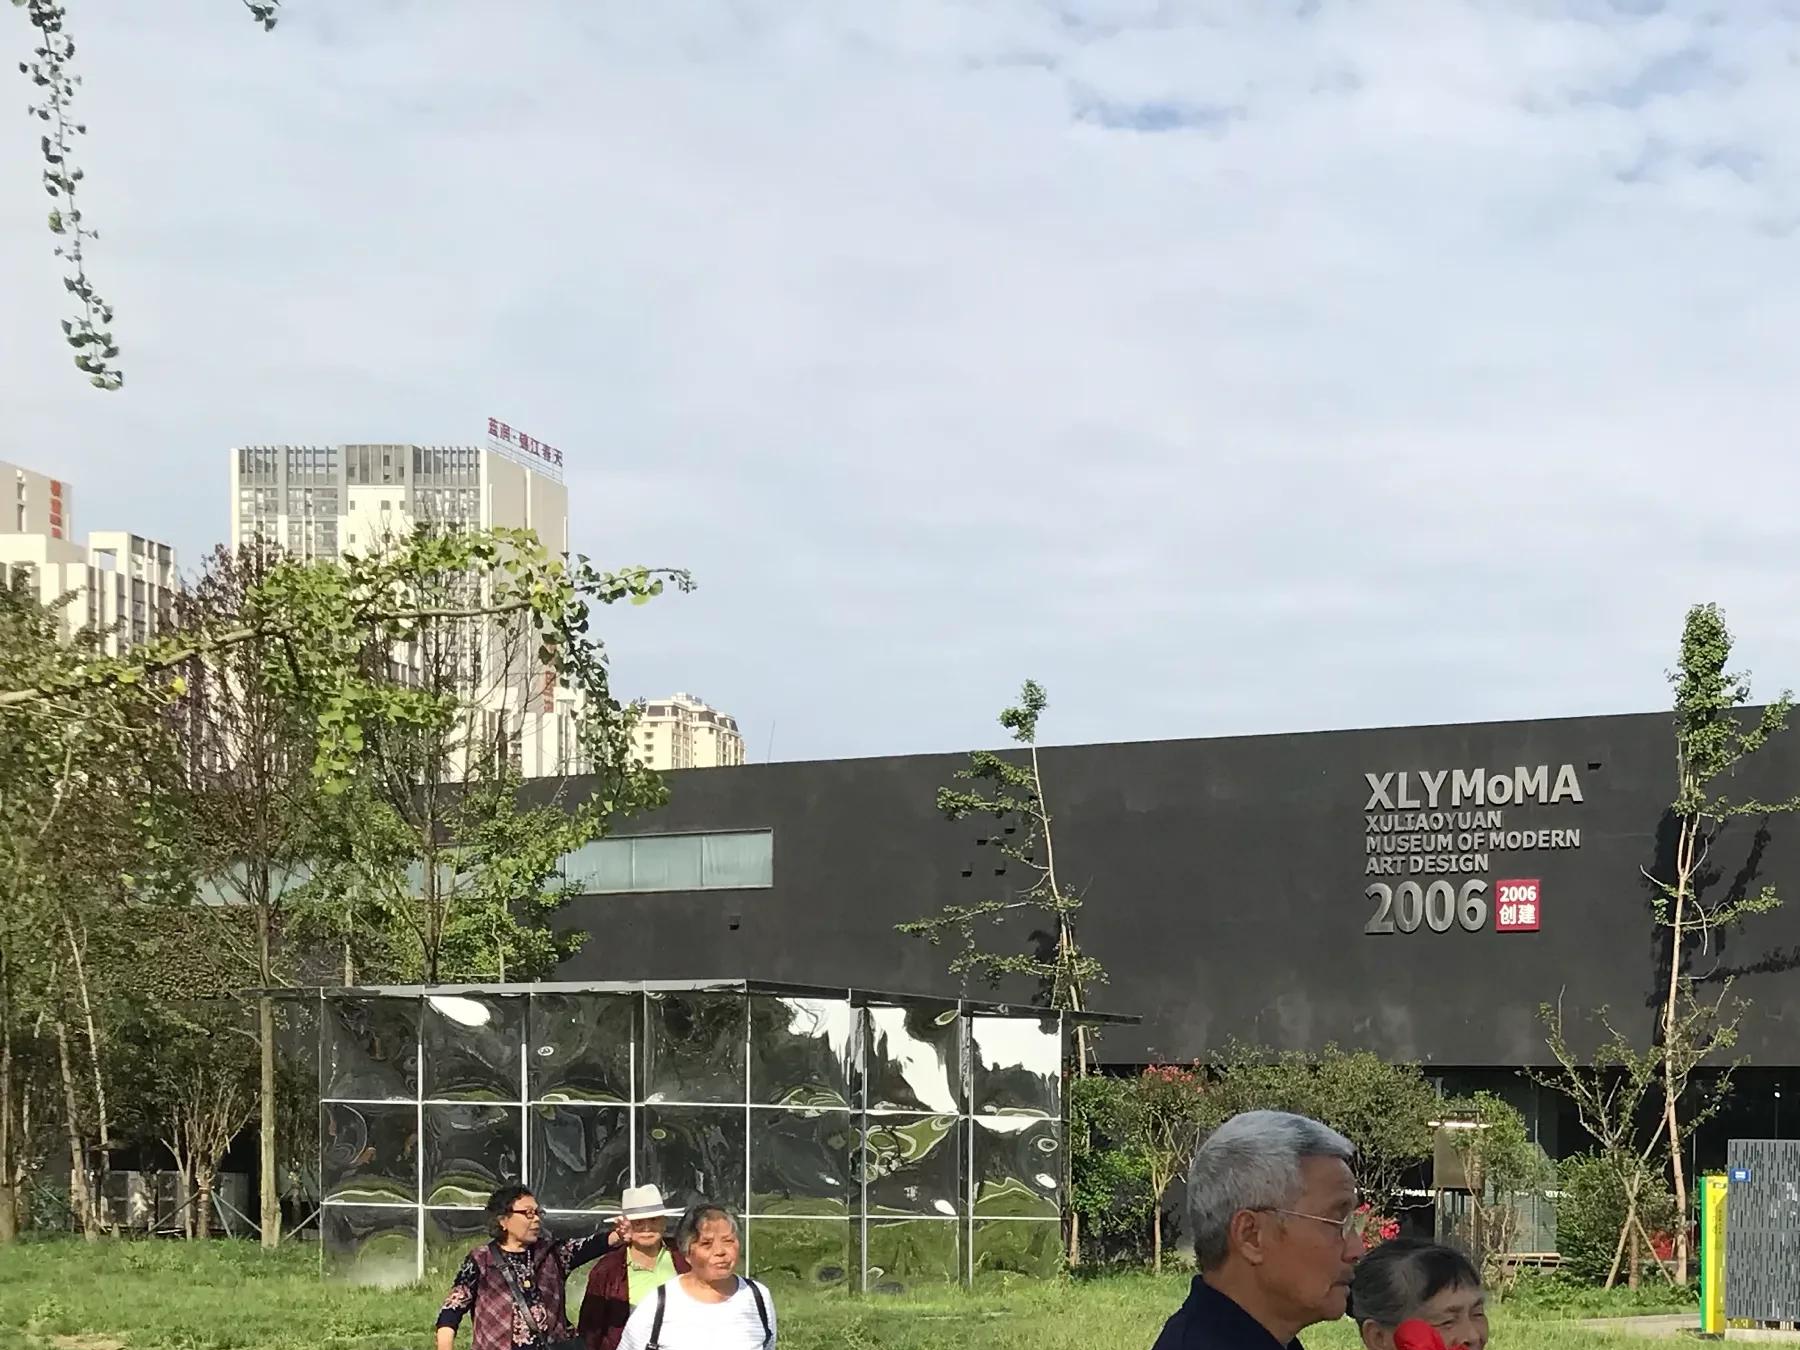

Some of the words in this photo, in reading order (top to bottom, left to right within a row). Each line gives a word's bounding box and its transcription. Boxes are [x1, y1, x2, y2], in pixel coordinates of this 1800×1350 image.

[1364, 764, 1584, 811] XLYMoMA
[1365, 811, 1503, 833] XULIAOYUAN
[1365, 834, 1453, 854] MUSEUM
[1457, 832, 1486, 851] OF
[1489, 829, 1581, 851] MODERN
[1365, 856, 1407, 875] ART
[1409, 854, 1489, 874] DESIGN
[1499, 886, 1537, 903] 2006
[1364, 879, 1489, 933] 2006
[1499, 904, 1536, 925] 创建
